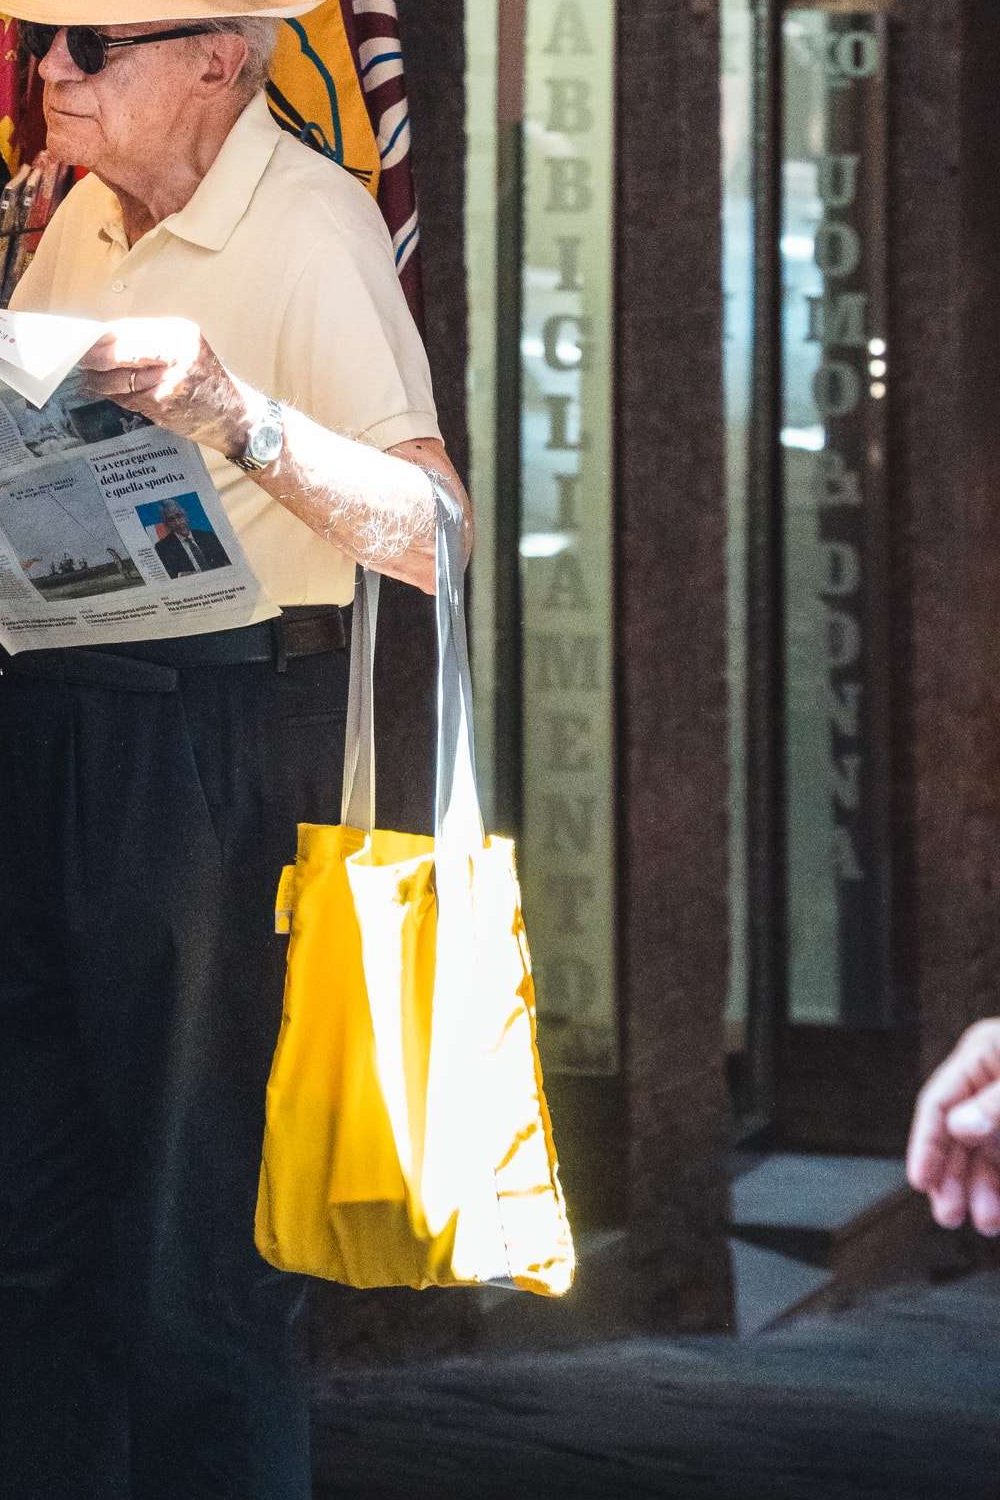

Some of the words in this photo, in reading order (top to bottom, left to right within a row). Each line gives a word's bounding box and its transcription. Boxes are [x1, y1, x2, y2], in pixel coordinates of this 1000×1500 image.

[95, 462, 107, 473] La
[107, 457, 130, 470] vera
[131, 446, 178, 465] egemonia
[100, 473, 125, 487] della
[126, 466, 157, 481] destra
[105, 488, 112, 498] è
[113, 483, 144, 499] quella
[145, 471, 185, 489] sportiva
[535, 0, 602, 1004] ABBIGLIAMENTO
